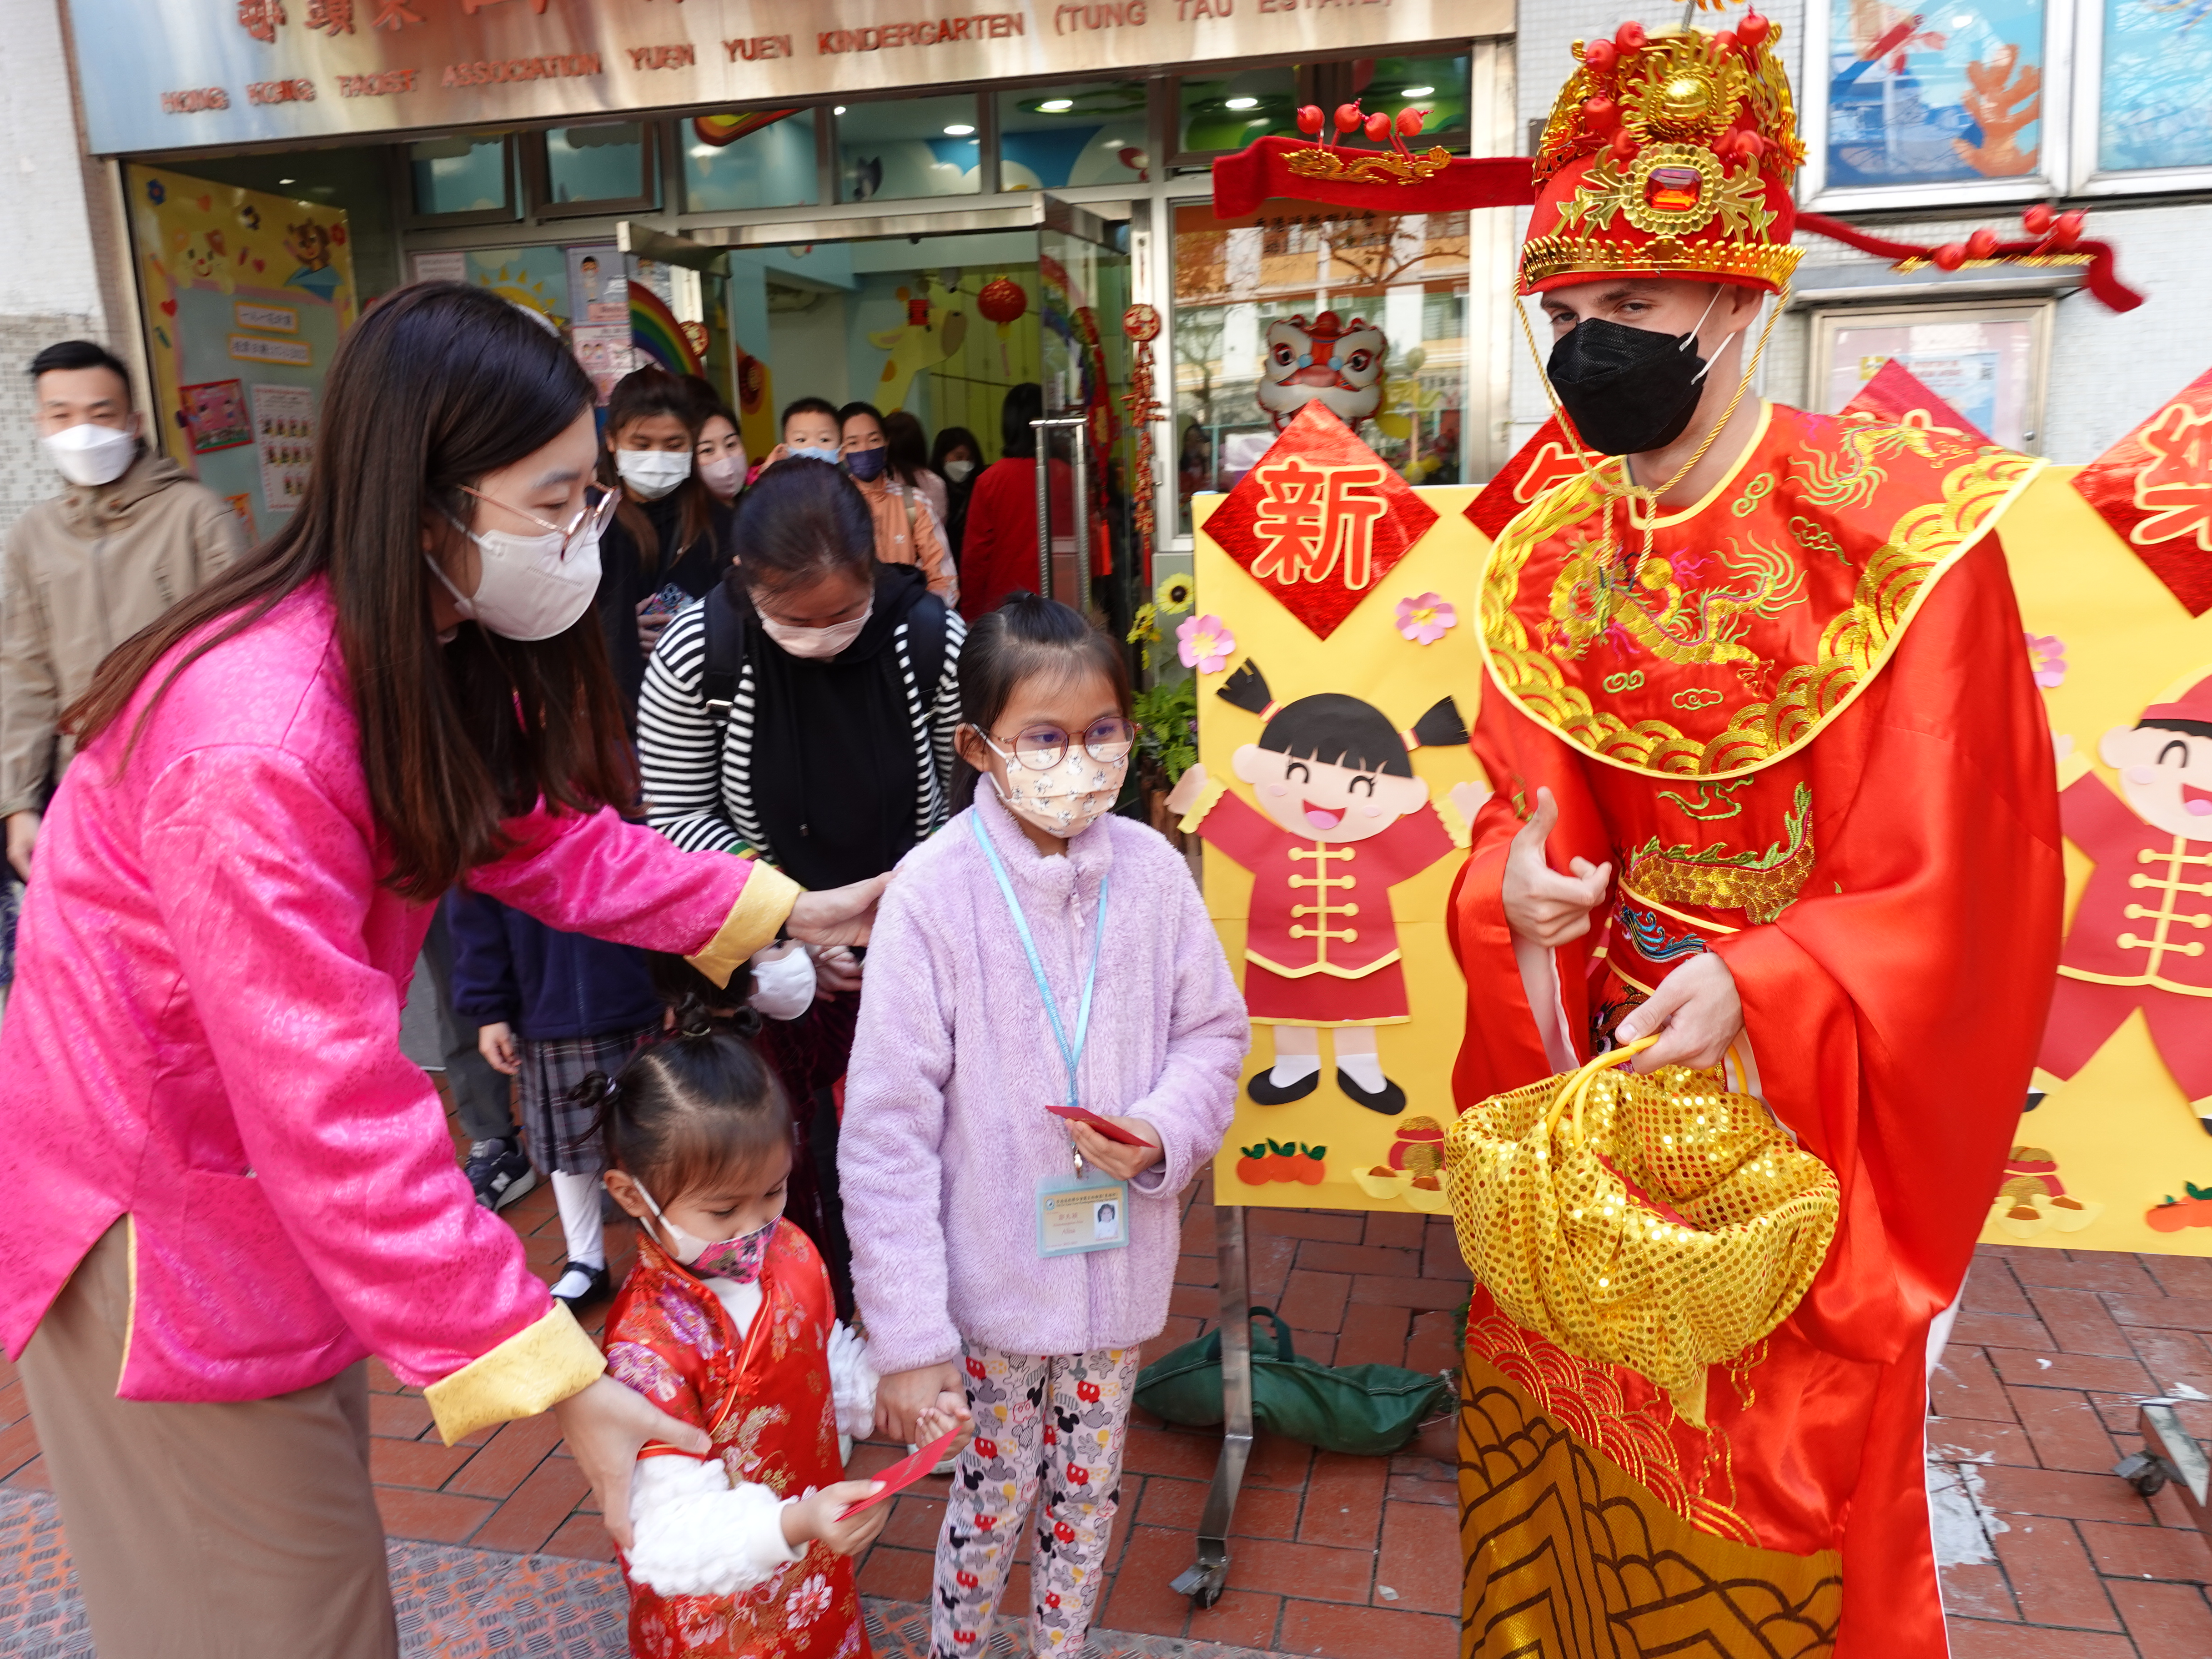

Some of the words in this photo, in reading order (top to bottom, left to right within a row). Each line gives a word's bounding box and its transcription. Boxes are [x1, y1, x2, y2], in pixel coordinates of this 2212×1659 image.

[160, 86, 230, 114] HONG
[246, 78, 317, 106] KONG
[441, 52, 602, 88] ASSOCIATION
[626, 44, 696, 70] YUEN
[721, 34, 793, 63] YUEN
[817, 12, 1025, 55] KINDERGARTEN
[1053, 1, 1147, 35] (TUNG
[1176, 0, 1233, 21] TAU
[1251, 455, 1388, 591] 新
